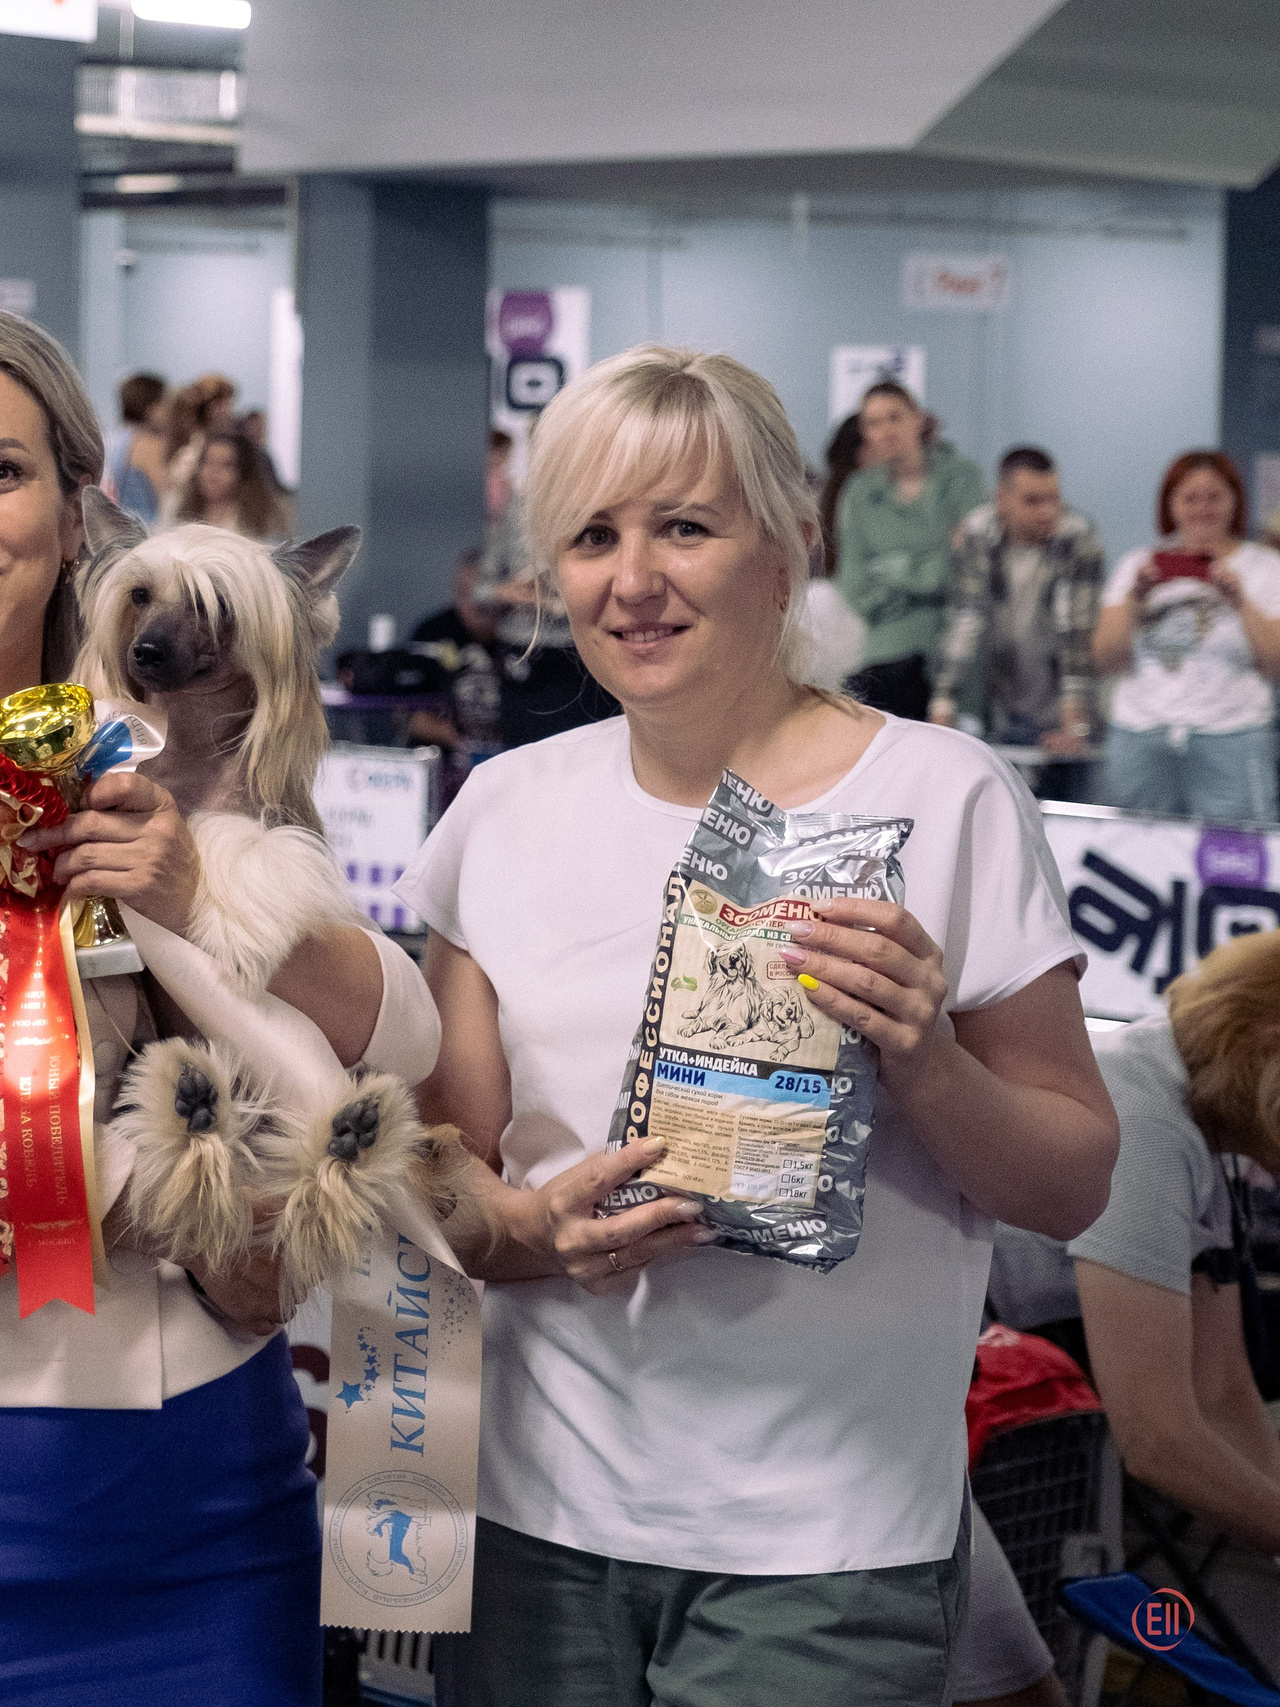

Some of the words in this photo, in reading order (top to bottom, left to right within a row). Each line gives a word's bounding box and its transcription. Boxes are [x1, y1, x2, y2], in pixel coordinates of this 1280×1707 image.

[626, 873, 686, 1143] РОФЕССИОНАЛ
[657, 1063, 706, 1087] МИНИ
[774, 1075, 821, 1094] 28/15
[793, 1160, 813, 1170] 1,5кг
[791, 1175, 805, 1184] 6кг
[790, 1189, 808, 1198] 18кг
